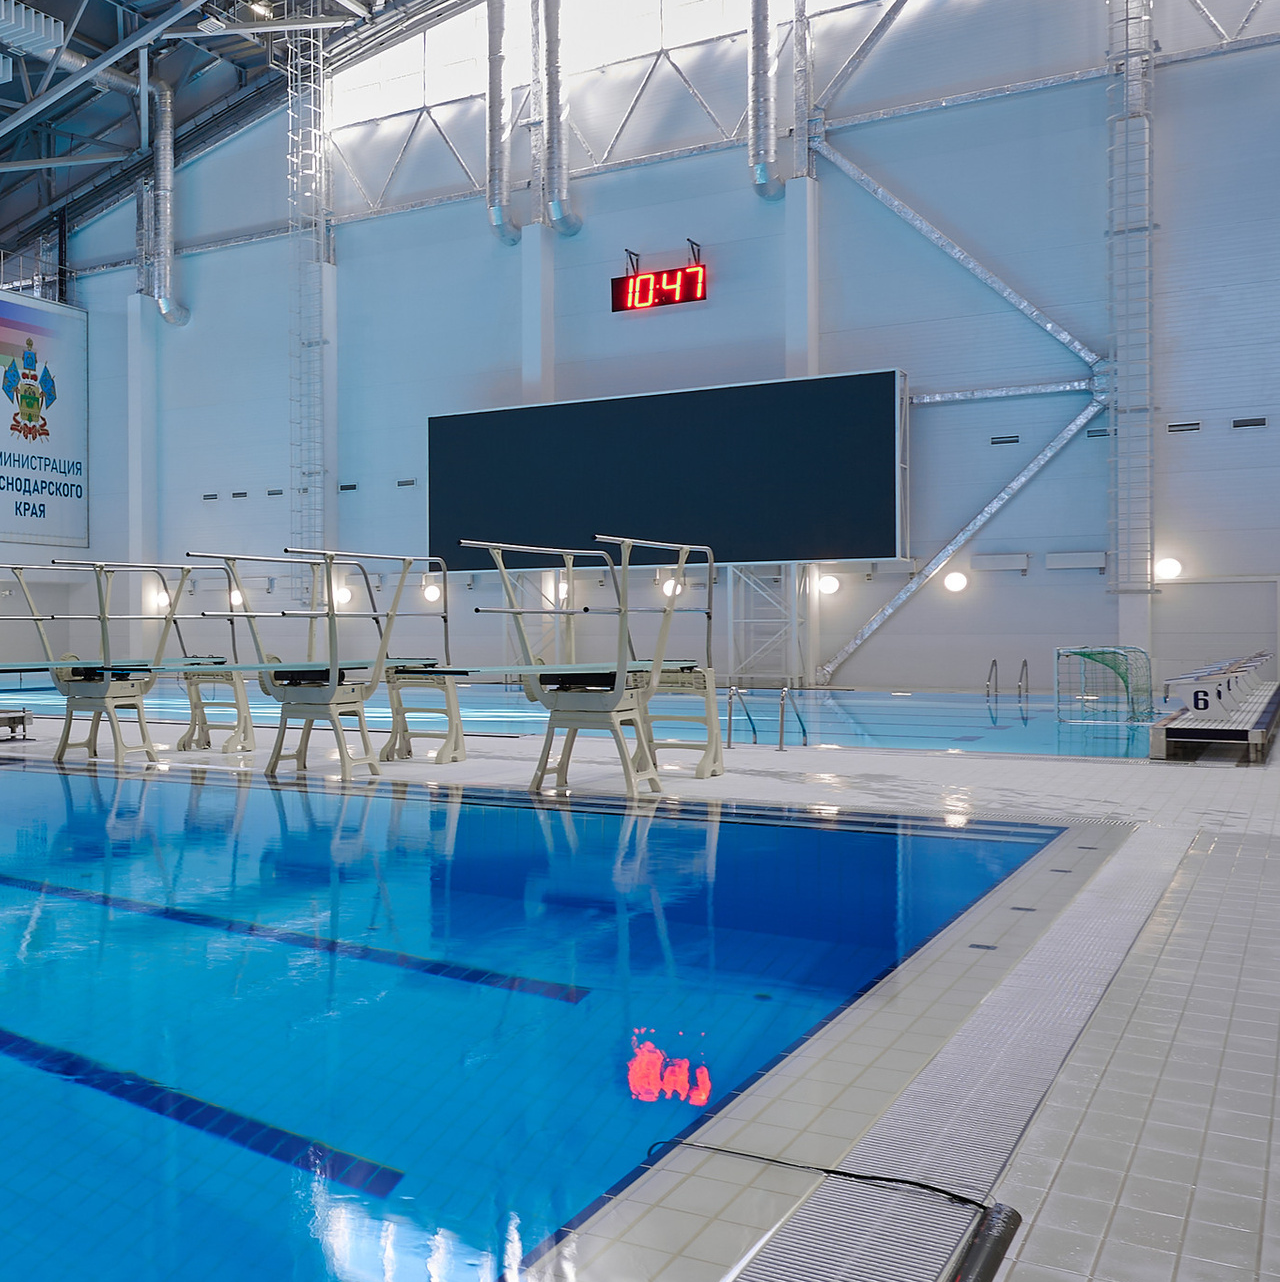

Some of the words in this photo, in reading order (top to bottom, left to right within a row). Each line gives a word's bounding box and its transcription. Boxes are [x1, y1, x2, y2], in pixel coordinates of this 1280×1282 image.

[627, 267, 703, 307] 10:47
[15, 501, 46, 518] КРАЯ
[1193, 690, 1209, 710] 6
